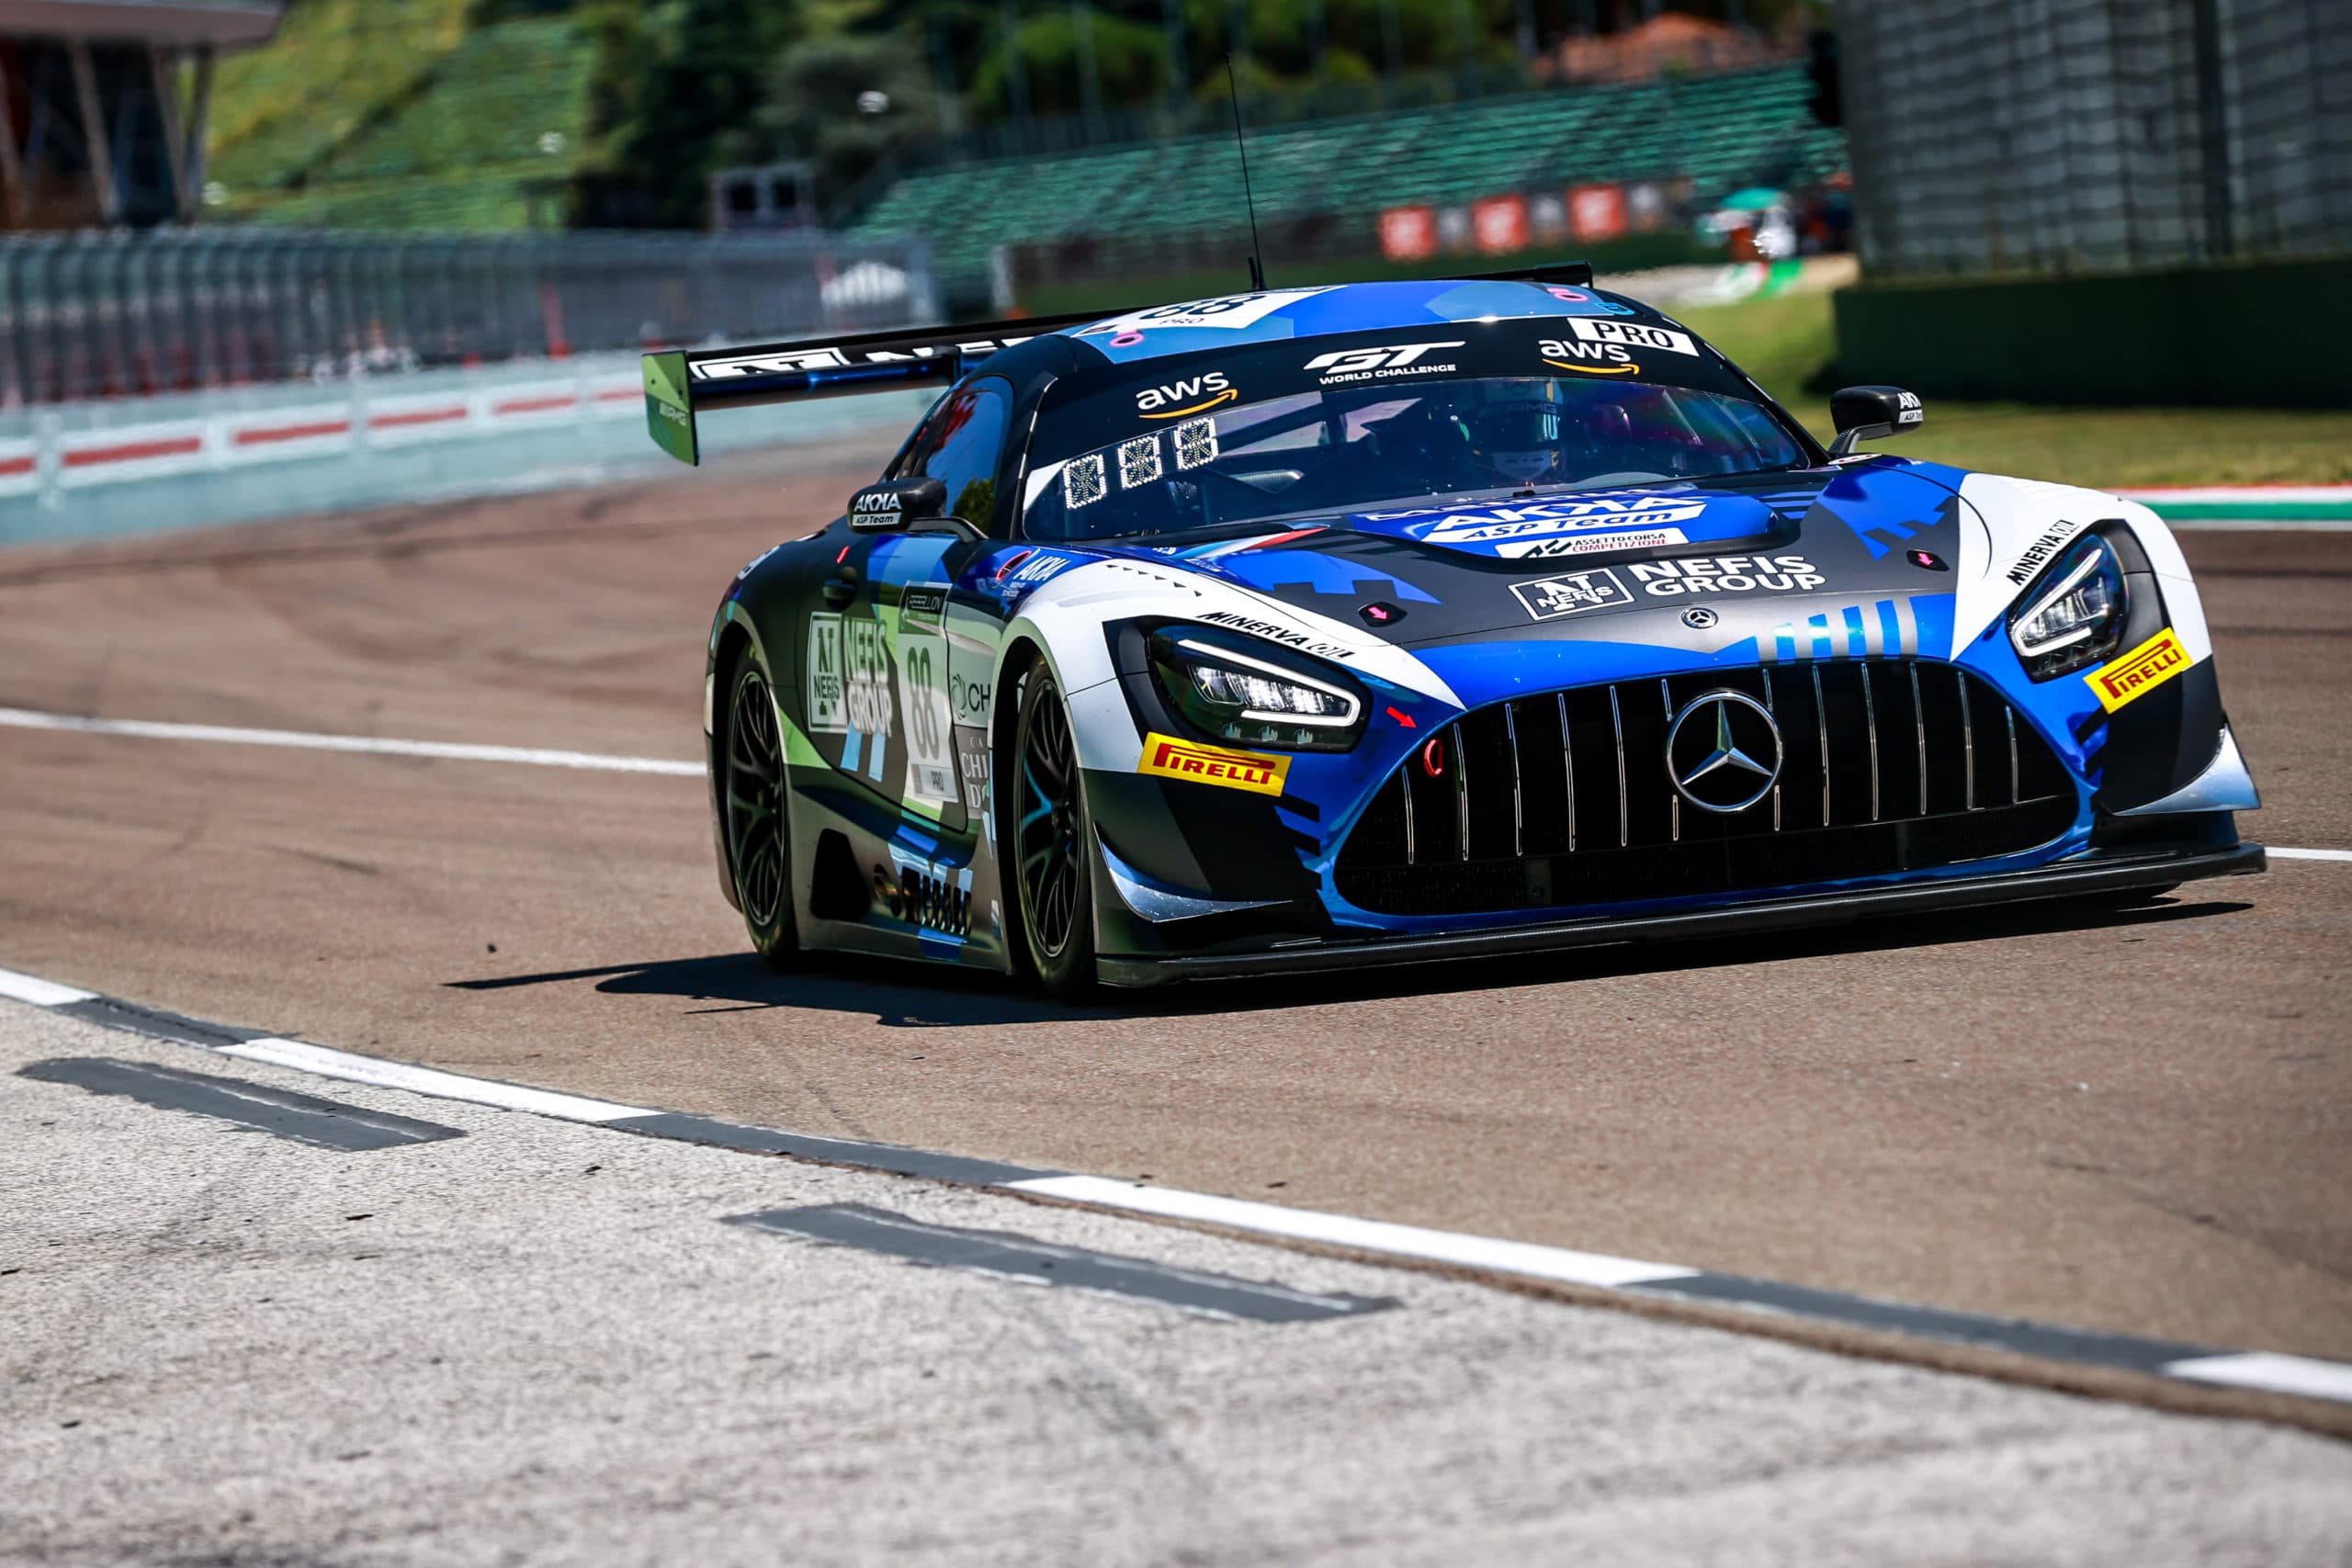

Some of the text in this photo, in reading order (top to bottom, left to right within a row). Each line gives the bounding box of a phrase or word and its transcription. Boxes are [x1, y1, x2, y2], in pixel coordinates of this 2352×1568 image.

[1591, 321, 1675, 348] PRO
[1303, 341, 1466, 375] GT
[1539, 339, 1632, 363] aws
[1319, 364, 1456, 386] WORLD CHALLENGE
[1136, 371, 1230, 411] aws
[869, 515, 894, 524] Team
[1463, 513, 1673, 540] ASP Team
[1572, 538, 1668, 552] COMPETIZIONE
[1574, 533, 1667, 547] ASSETTO CORSA
[1628, 556, 1817, 581] NEFIS
[2007, 532, 2064, 586] MINERVA
[1536, 586, 1614, 608] NEFIS
[1645, 573, 1826, 595] GROUP
[1195, 612, 1308, 647] MINERVA
[843, 616, 889, 684] NEFIS
[2100, 638, 2183, 699] PIRELLI
[814, 675, 840, 700] NEFIS
[967, 682, 989, 713] CH
[847, 683, 893, 738] GROUP
[907, 646, 940, 761] 88
[1153, 742, 1276, 784] PIRELLI
